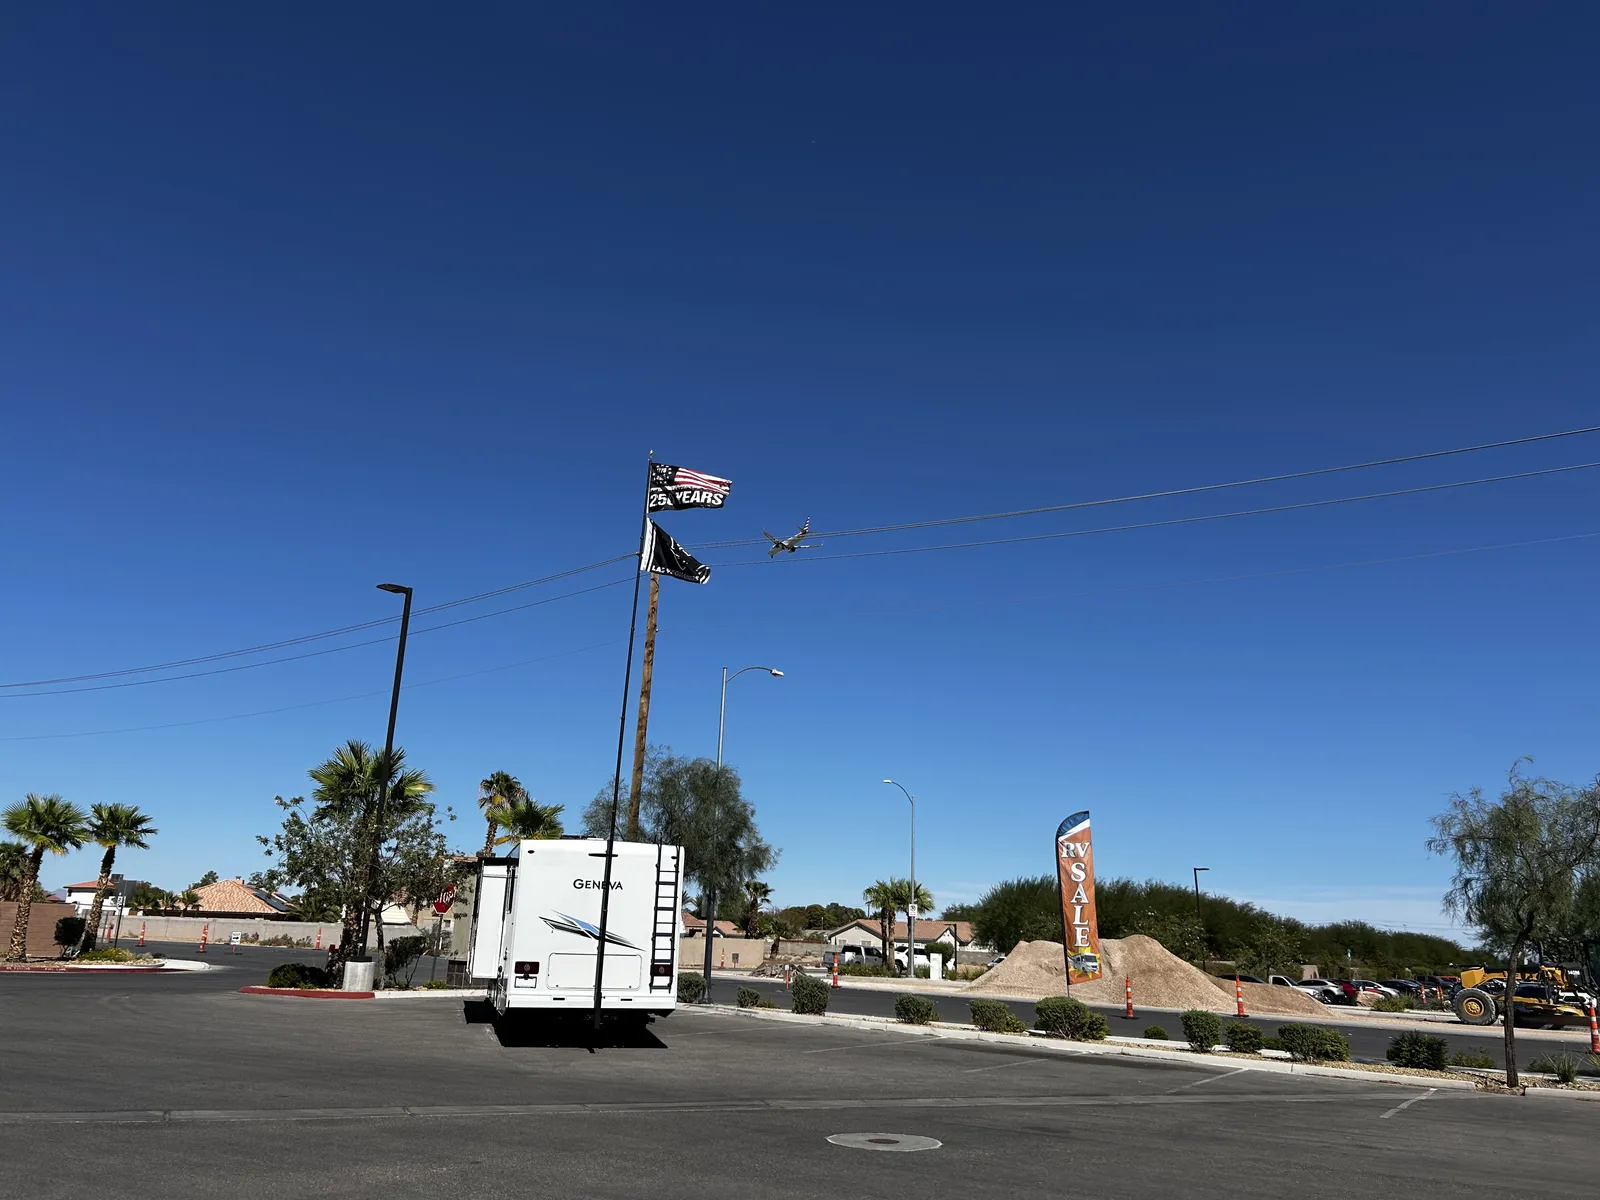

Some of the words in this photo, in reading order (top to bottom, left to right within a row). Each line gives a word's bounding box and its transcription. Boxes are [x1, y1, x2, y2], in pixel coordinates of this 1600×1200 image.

[675, 490, 724, 505] YEARS
[1061, 842, 1090, 858] RV
[1070, 862, 1090, 947] SALE
